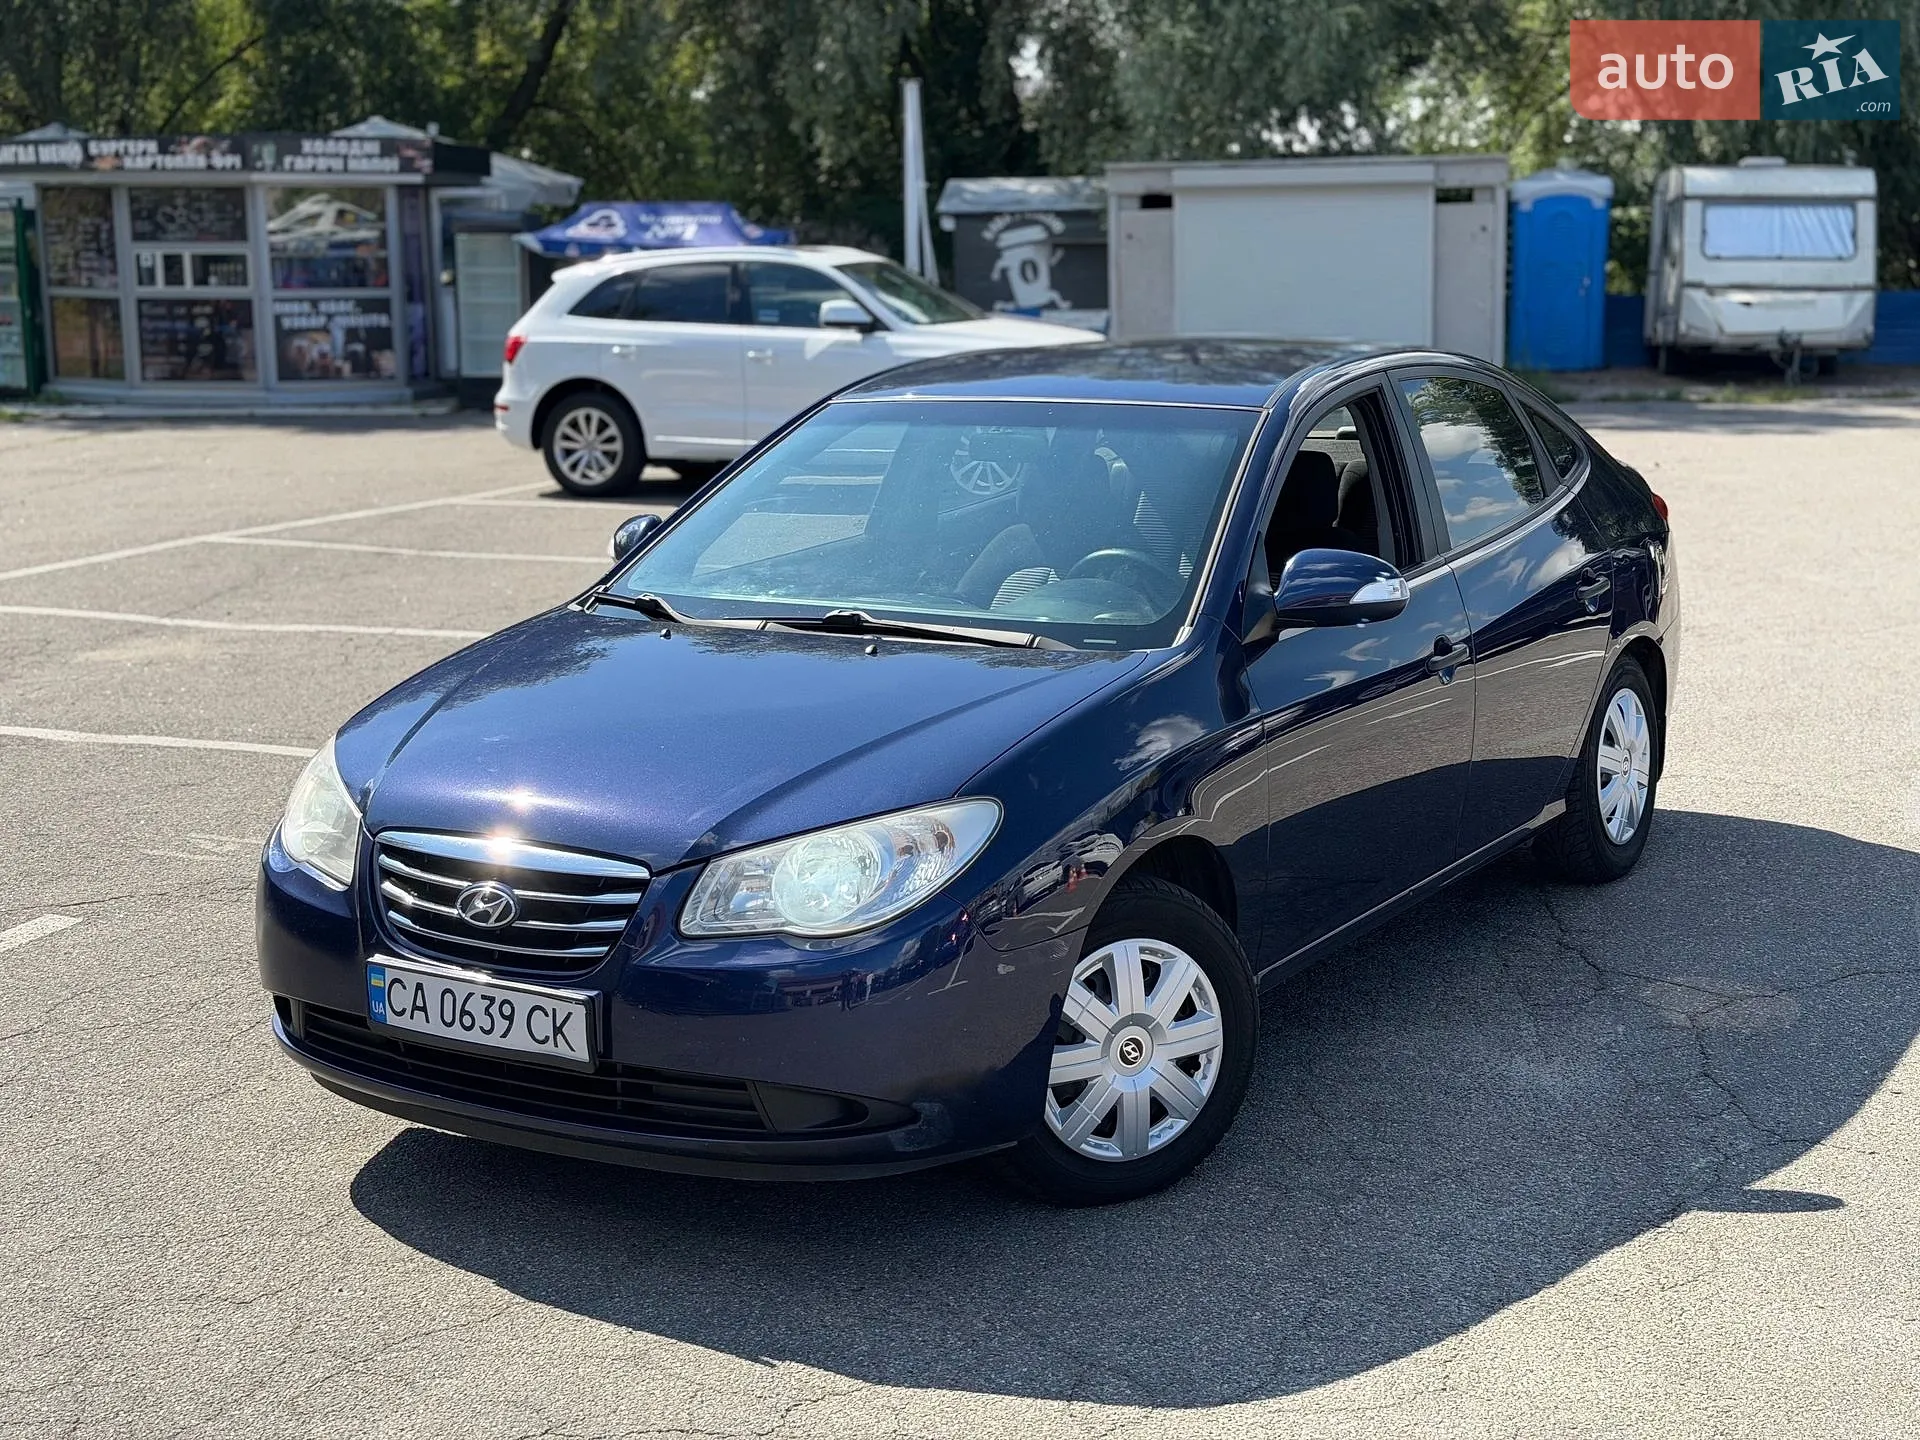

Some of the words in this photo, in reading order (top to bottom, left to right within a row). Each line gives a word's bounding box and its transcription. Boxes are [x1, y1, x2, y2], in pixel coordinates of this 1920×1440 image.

[371, 1001, 386, 1015] UA
[387, 977, 430, 1024] CA
[440, 988, 516, 1039] 0639
[526, 1004, 576, 1053] CK
